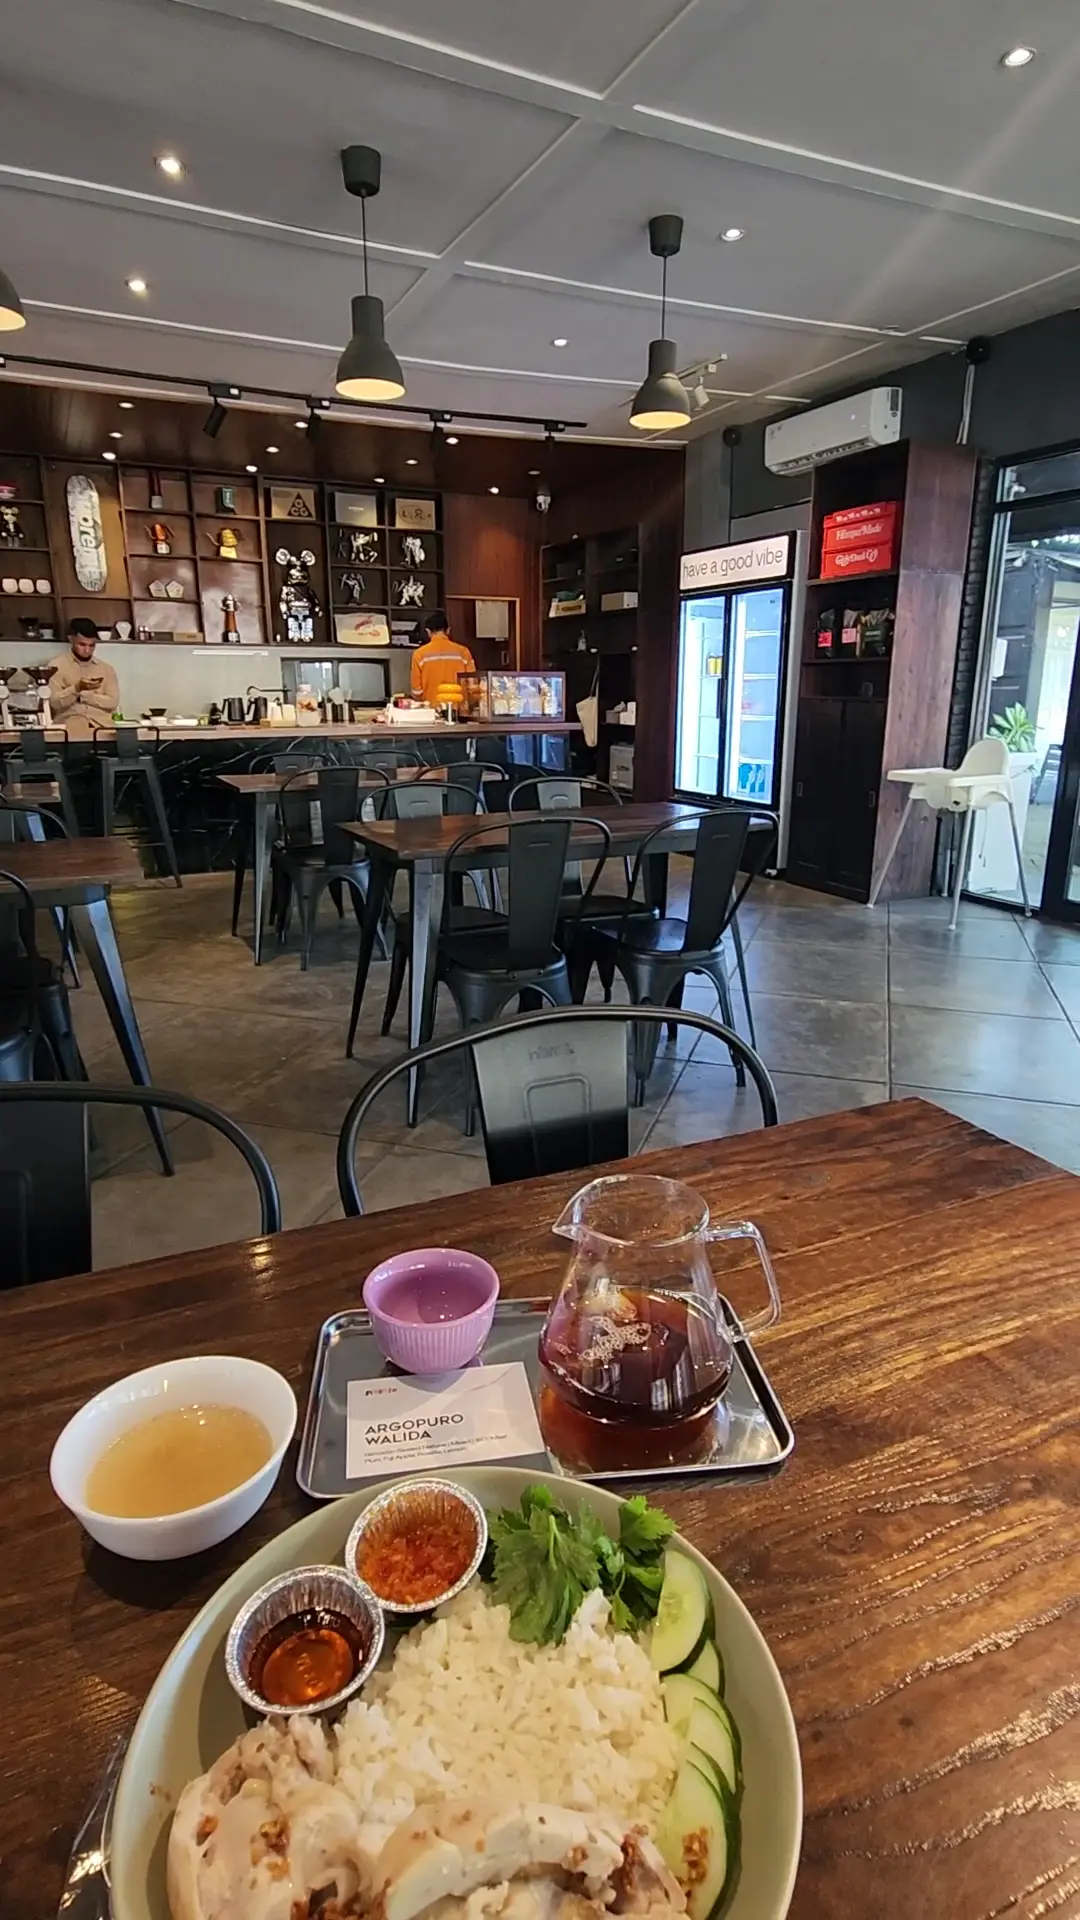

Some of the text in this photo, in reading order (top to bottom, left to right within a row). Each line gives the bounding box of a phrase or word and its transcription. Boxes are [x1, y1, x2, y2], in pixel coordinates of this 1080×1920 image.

[682, 546, 784, 579] have a good vibe
[365, 1413, 464, 1435] ARGOPURO
[365, 1430, 432, 1445] WALIDA
